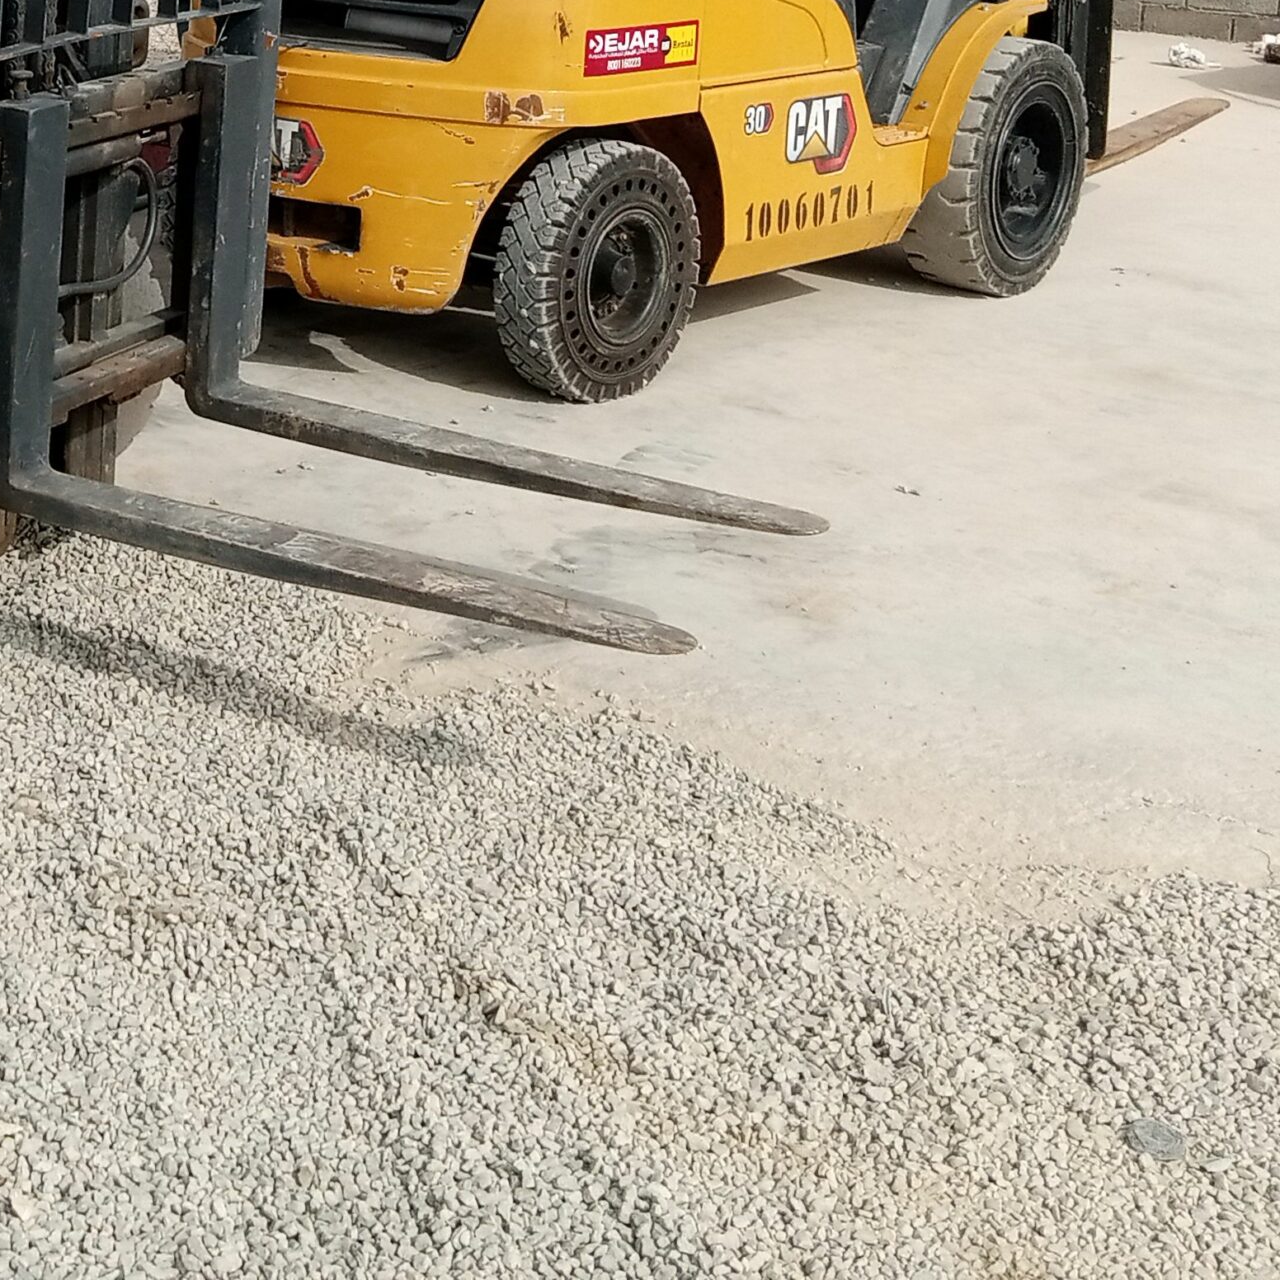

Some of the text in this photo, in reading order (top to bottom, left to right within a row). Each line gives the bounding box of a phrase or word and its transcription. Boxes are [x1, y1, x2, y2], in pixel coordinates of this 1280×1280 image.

[744, 104, 766, 134] 30
[786, 95, 843, 162] CAT
[745, 180, 875, 242] 10060701
